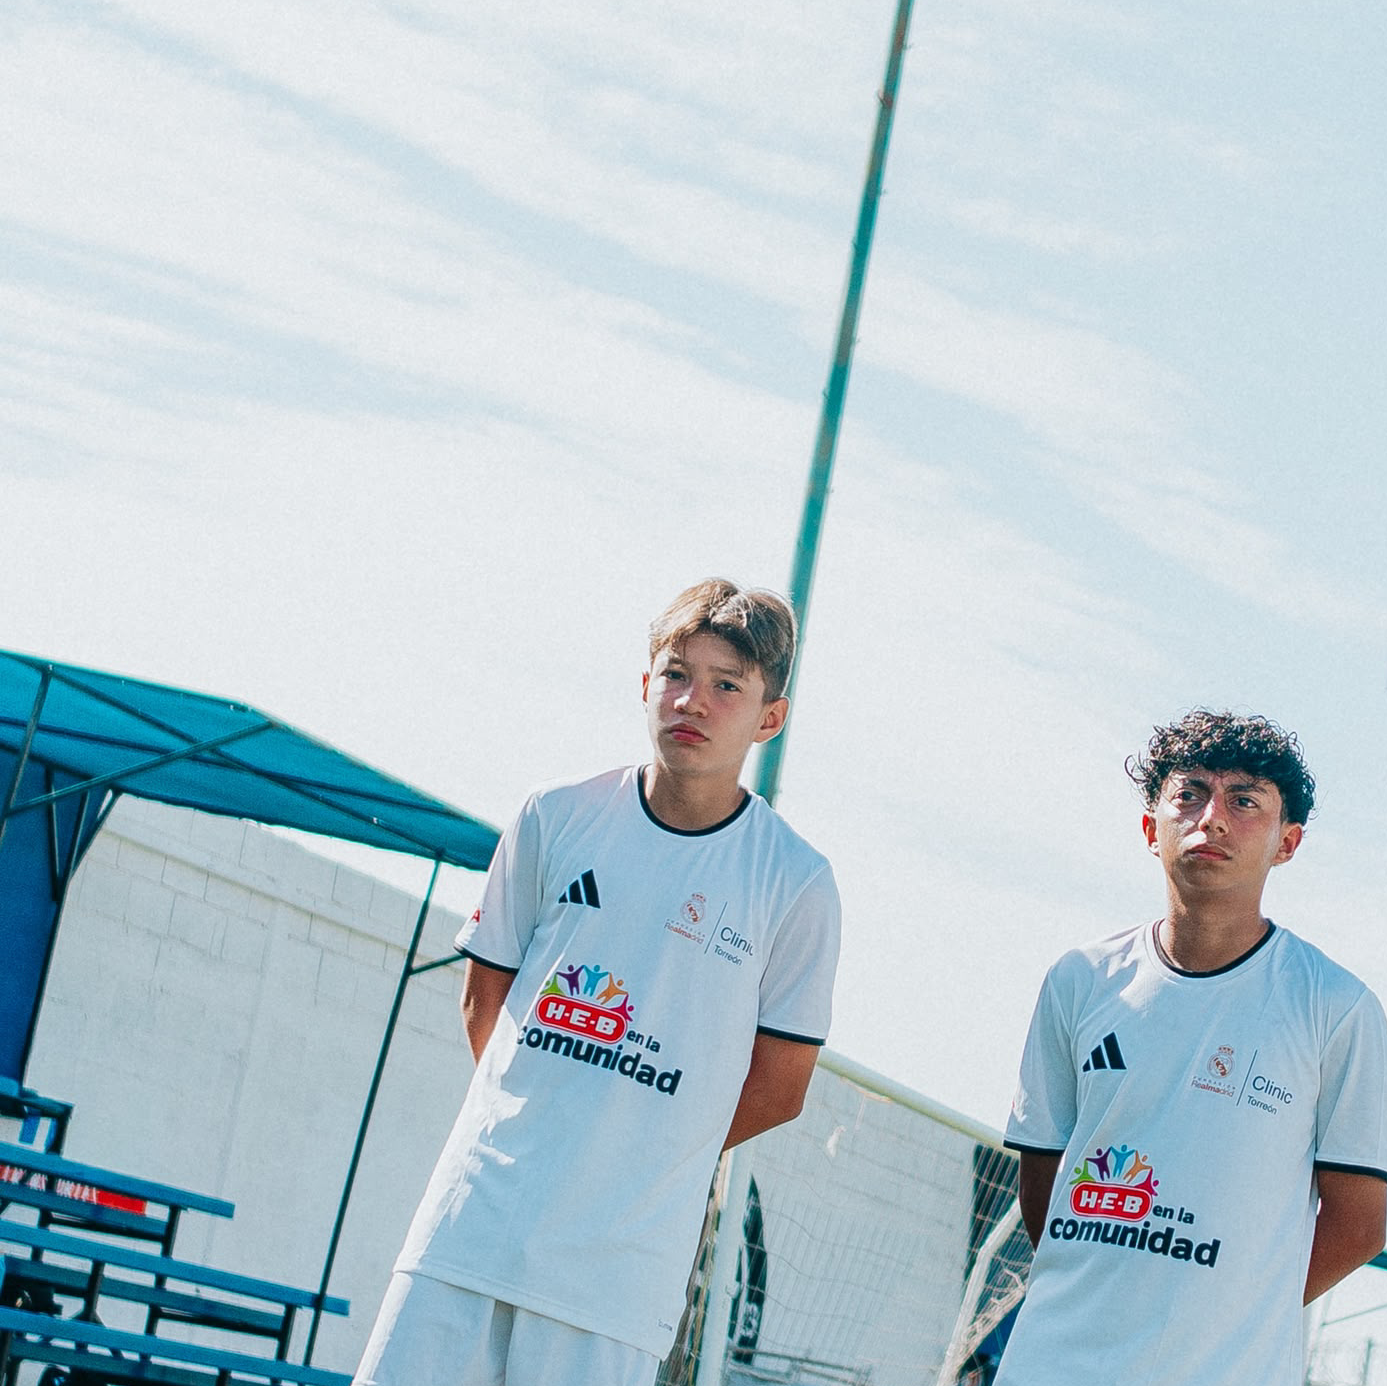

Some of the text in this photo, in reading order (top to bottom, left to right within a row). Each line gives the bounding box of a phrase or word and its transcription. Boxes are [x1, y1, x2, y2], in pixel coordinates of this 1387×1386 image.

[714, 944, 743, 967] Torreón
[626, 1030, 645, 1046] en
[645, 1035, 661, 1053] la
[1252, 1075, 1293, 1104] Clinic
[1247, 1094, 1277, 1115] Torreón
[1152, 1204, 1174, 1220] en
[1177, 1207, 1195, 1224] la
[1049, 1217, 1222, 1268] comunidad
